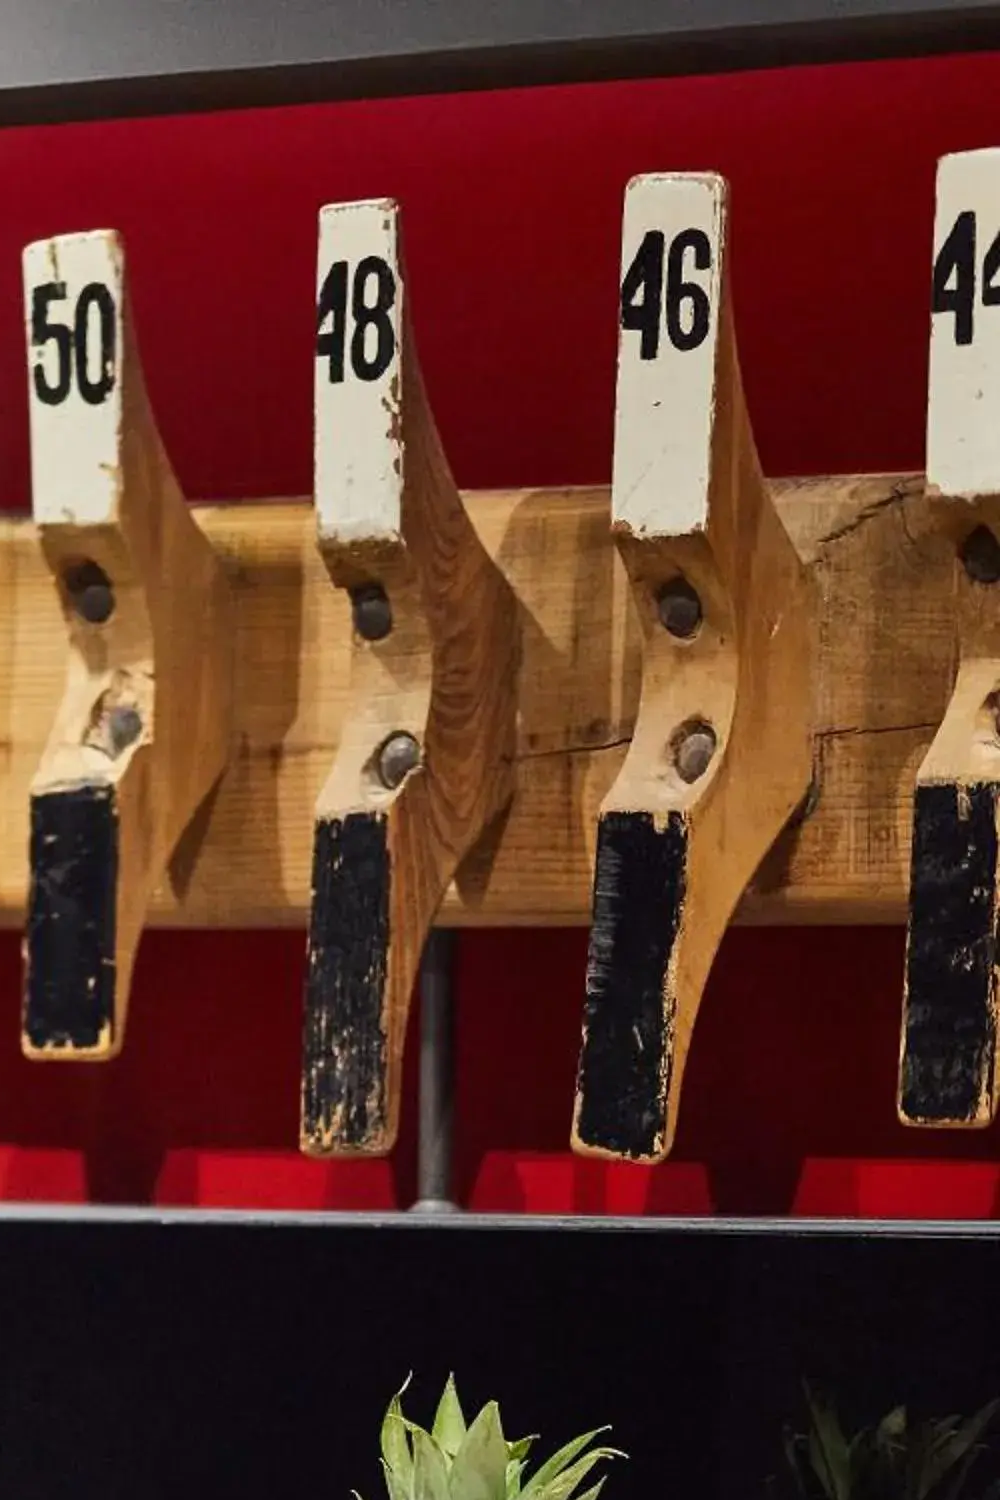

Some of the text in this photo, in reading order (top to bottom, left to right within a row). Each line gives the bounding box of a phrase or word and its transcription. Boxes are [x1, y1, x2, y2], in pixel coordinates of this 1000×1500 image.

[31, 282, 116, 405] 50
[316, 256, 397, 383] 48
[621, 228, 711, 360] 46
